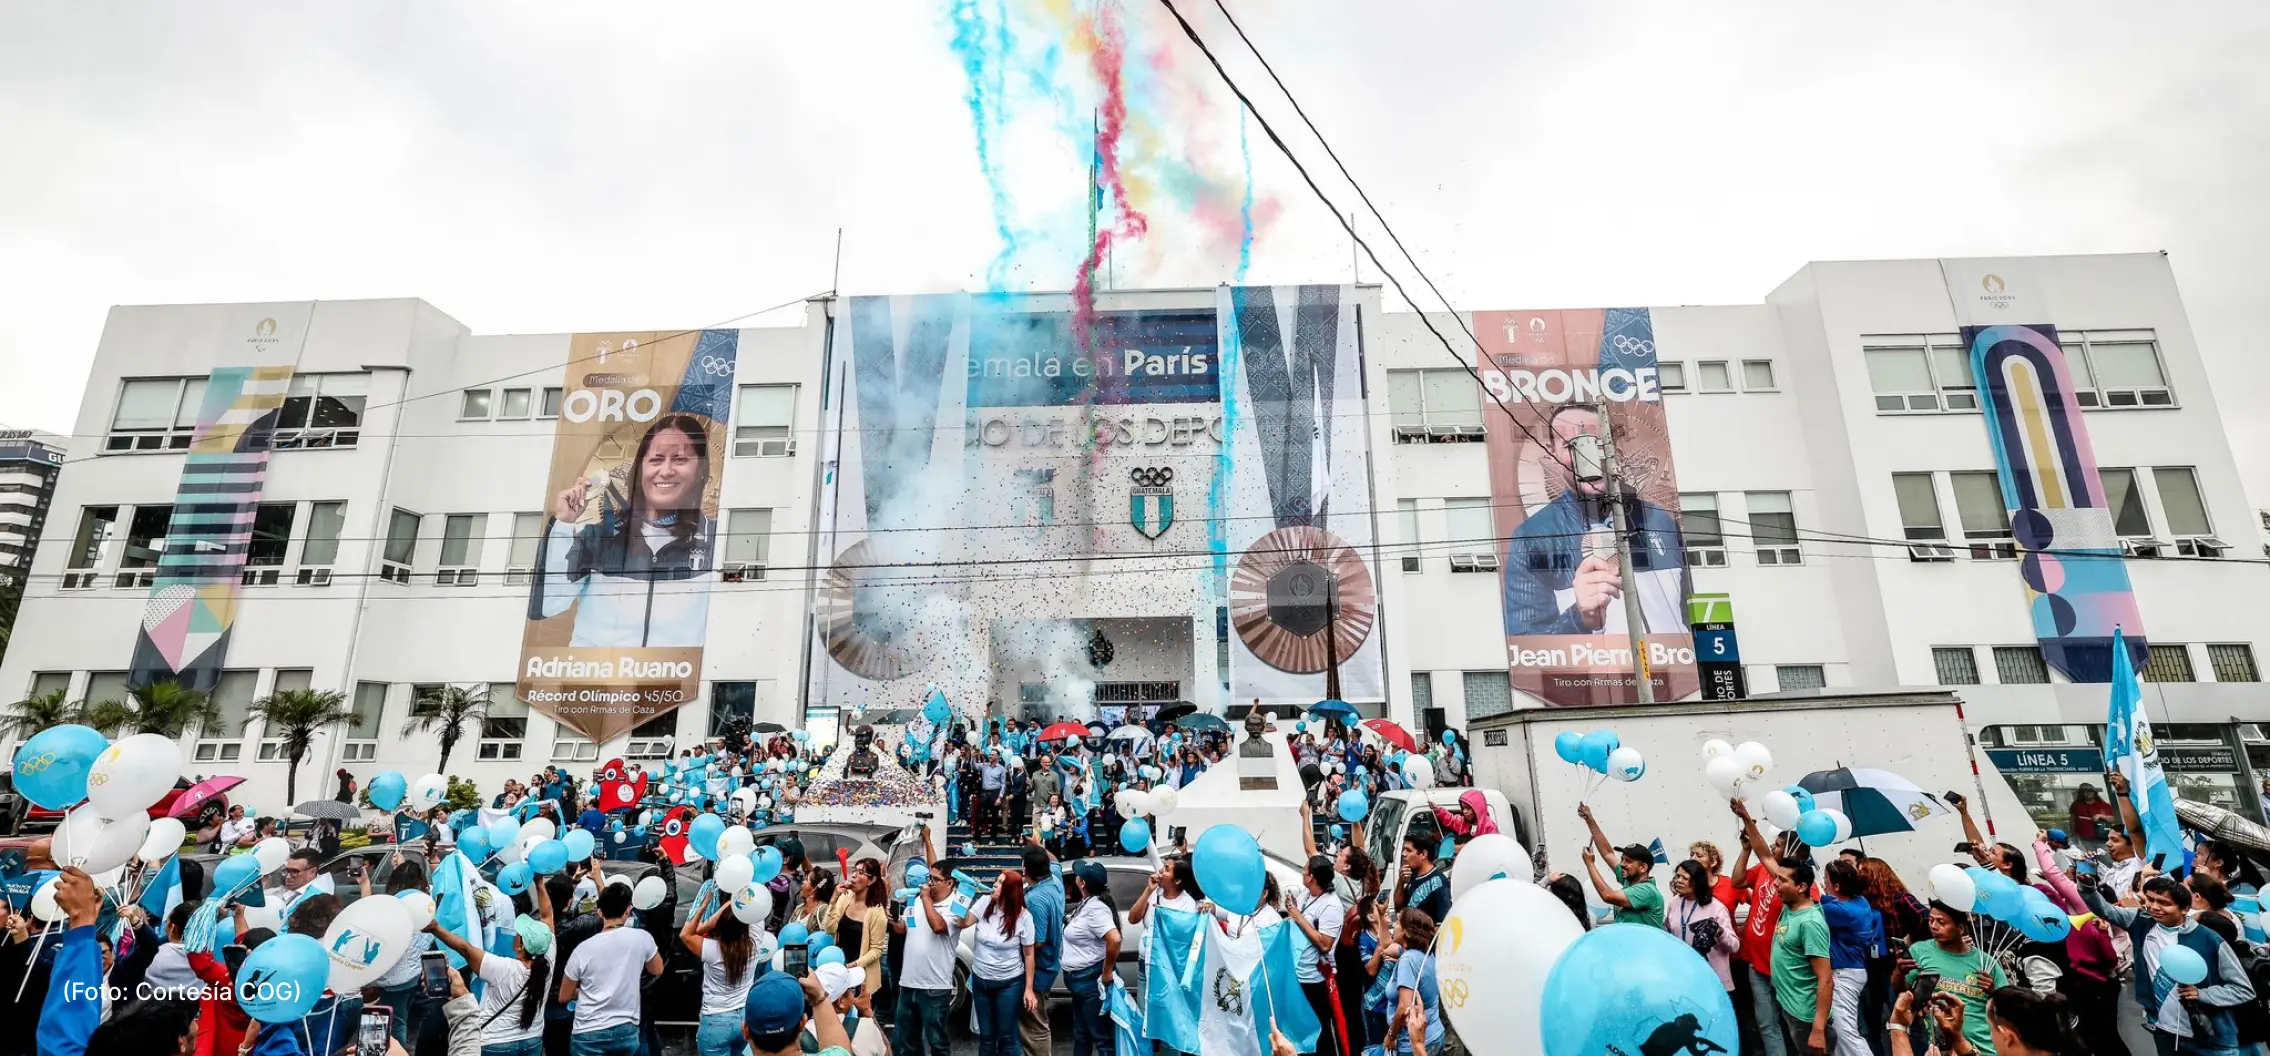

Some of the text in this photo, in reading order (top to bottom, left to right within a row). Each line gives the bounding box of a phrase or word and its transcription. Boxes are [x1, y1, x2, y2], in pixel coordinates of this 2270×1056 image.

[968, 346, 1208, 377] emala en París
[1482, 367, 1660, 404] BRONCE
[563, 388, 662, 424] ORO
[1132, 487, 1171, 495] GUATEMALA
[1509, 645, 1567, 667] Jean
[1570, 643, 1633, 667] Pierr
[1650, 643, 1696, 666] Bro
[1713, 637, 1725, 655] 5
[526, 655, 693, 679] Adriana Ruano
[1554, 678, 1571, 687] Tiro
[1594, 678, 1623, 687] Armas
[1625, 678, 1637, 687] de
[1723, 670, 1737, 700] ORTES
[528, 689, 684, 704] Récord Olímpico 45/50
[554, 705, 655, 714] Tiro con Armas de Caza
[2016, 751, 2069, 766] LÍNEA 5
